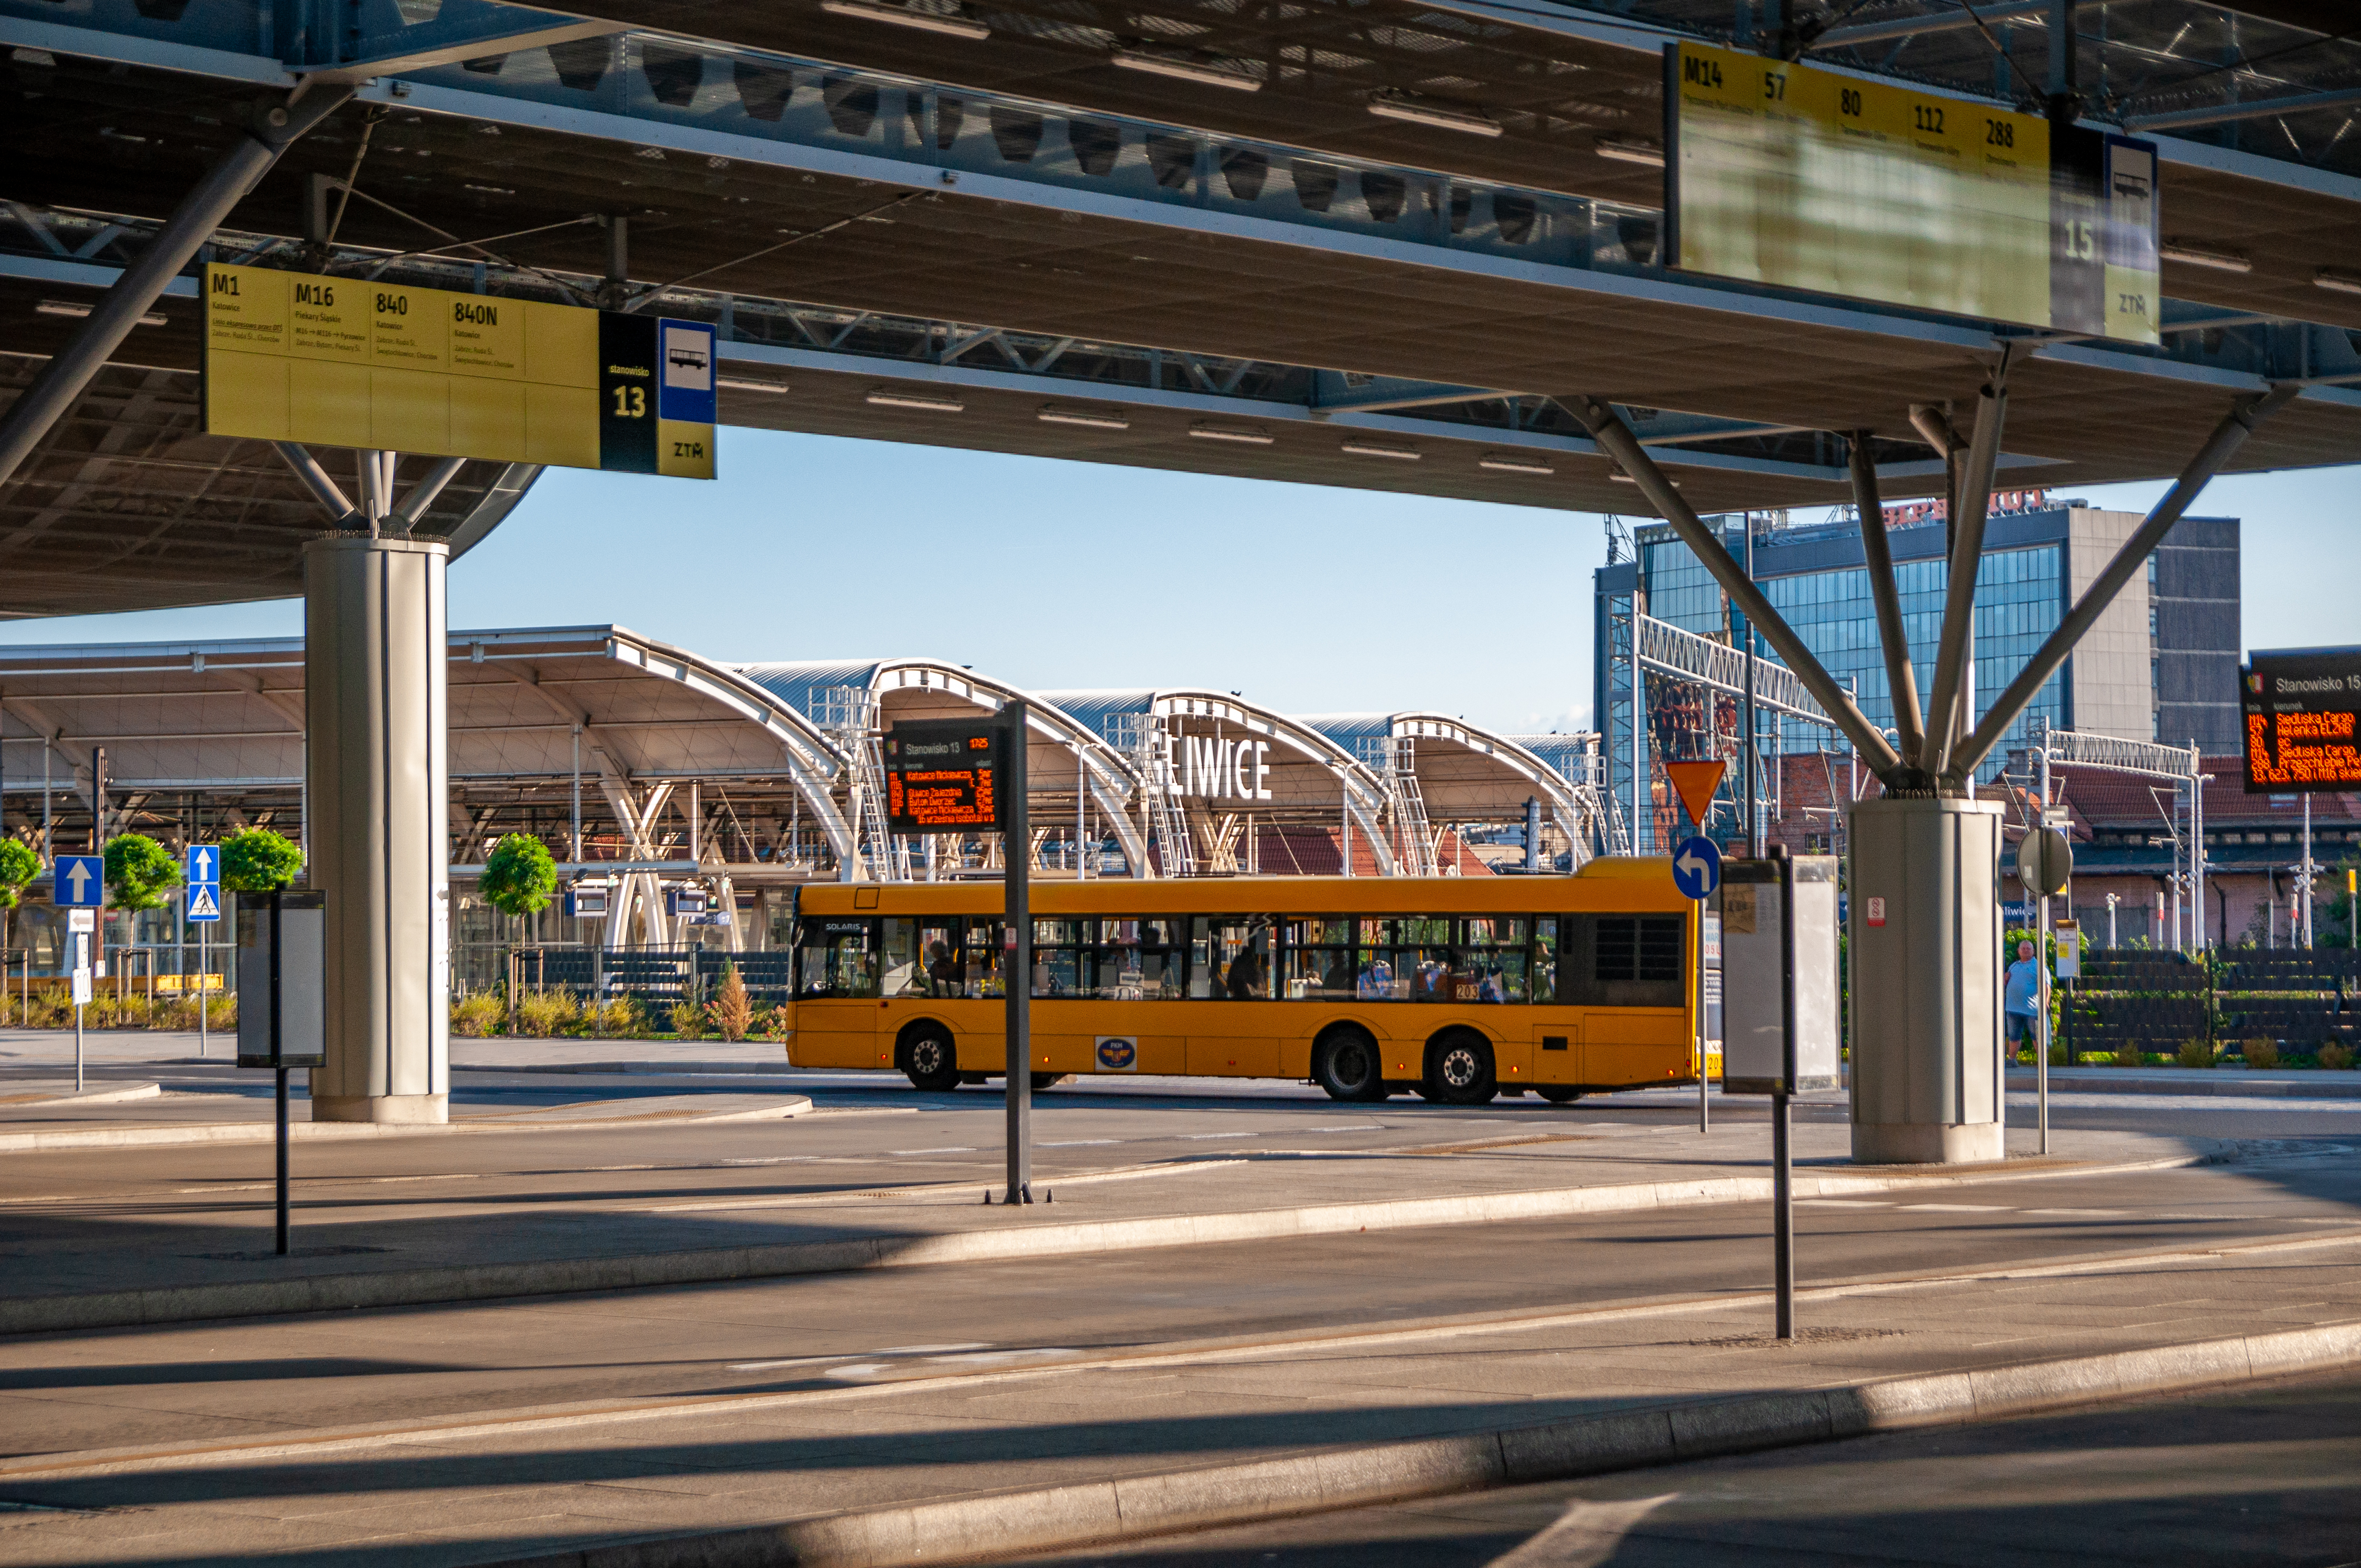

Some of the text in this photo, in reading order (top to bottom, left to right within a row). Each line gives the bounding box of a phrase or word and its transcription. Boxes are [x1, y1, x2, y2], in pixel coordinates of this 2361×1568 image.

[1685, 56, 1722, 88] M14
[1765, 72, 1786, 100] 57
[1841, 88, 1861, 116] 80
[1915, 105, 1944, 134] 112
[1986, 118, 2014, 148] 288
[2065, 219, 2093, 260] 15
[213, 273, 240, 296] M1
[296, 283, 334, 306] M16
[213, 301, 240, 312] Katowice
[377, 293, 407, 315] 840
[455, 302, 498, 325] 840N
[295, 311, 319, 322] Piekary
[376, 321, 403, 330] Katowice
[455, 329, 481, 339] Katowice
[609, 364, 650, 378] stanowisko
[613, 385, 646, 418] 13
[2276, 675, 2360, 694] Stanowisko 15
[2248, 710, 2355, 728] M14 Siedliska Cargo
[2277, 722, 2320, 738] Helenka
[2320, 722, 2353, 737] ELZAB
[906, 743, 948, 755] Stanowisko
[950, 742, 960, 753] 13
[2251, 743, 2357, 760] M14 Siedliska Cargo
[1152, 733, 1272, 799] LIWICE
[76, 973, 89, 998] 10
[1457, 984, 1479, 999] 203
